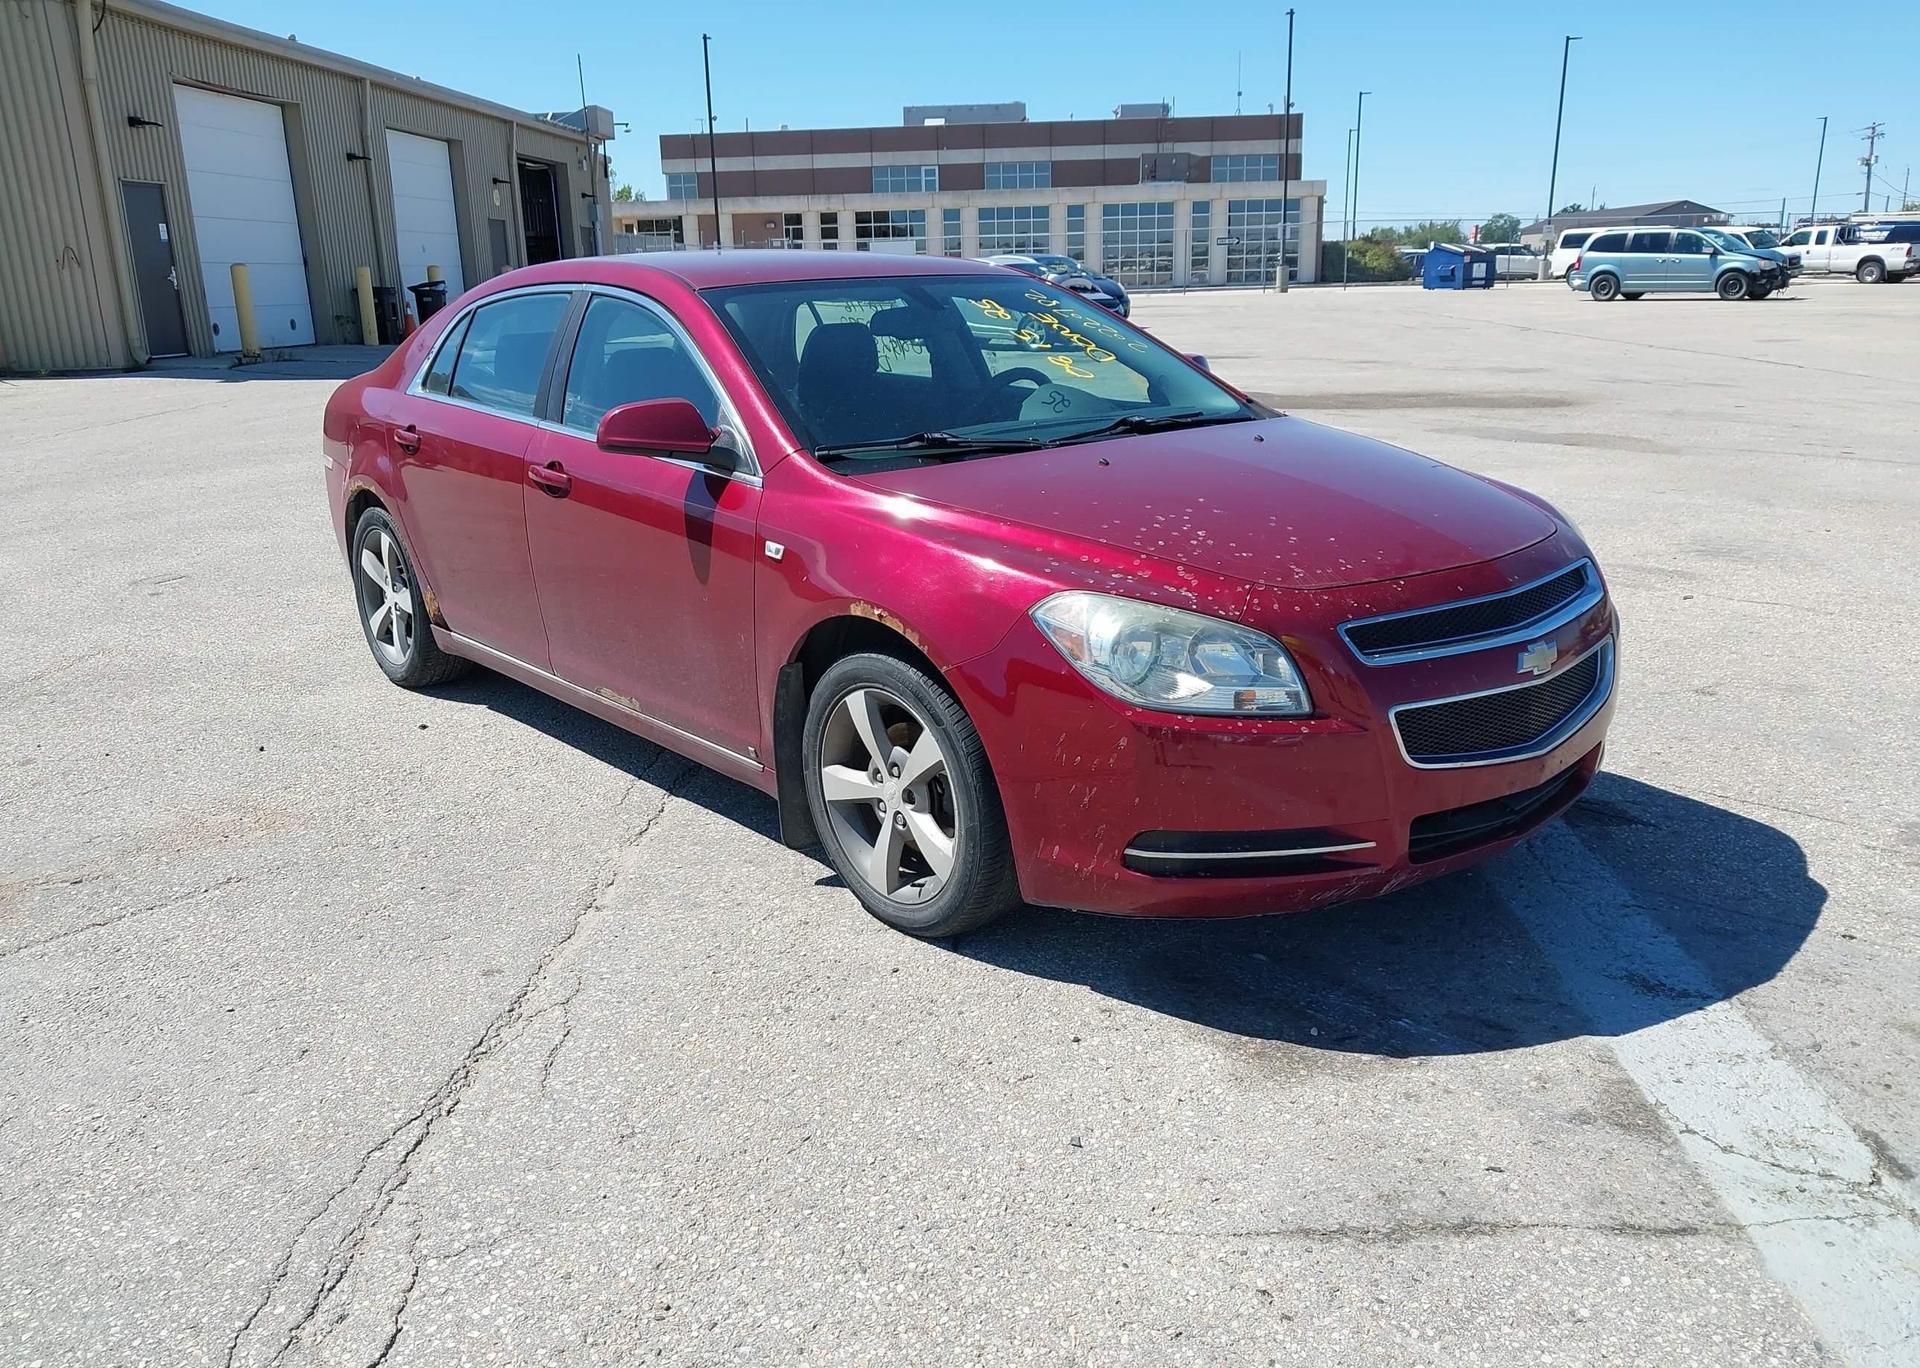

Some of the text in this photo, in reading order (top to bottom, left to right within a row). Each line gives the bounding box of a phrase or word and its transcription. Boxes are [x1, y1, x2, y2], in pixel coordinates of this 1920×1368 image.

[968, 299, 1012, 320] 25
[1027, 312, 1117, 362] DONE
[1041, 390, 1071, 413] 25
